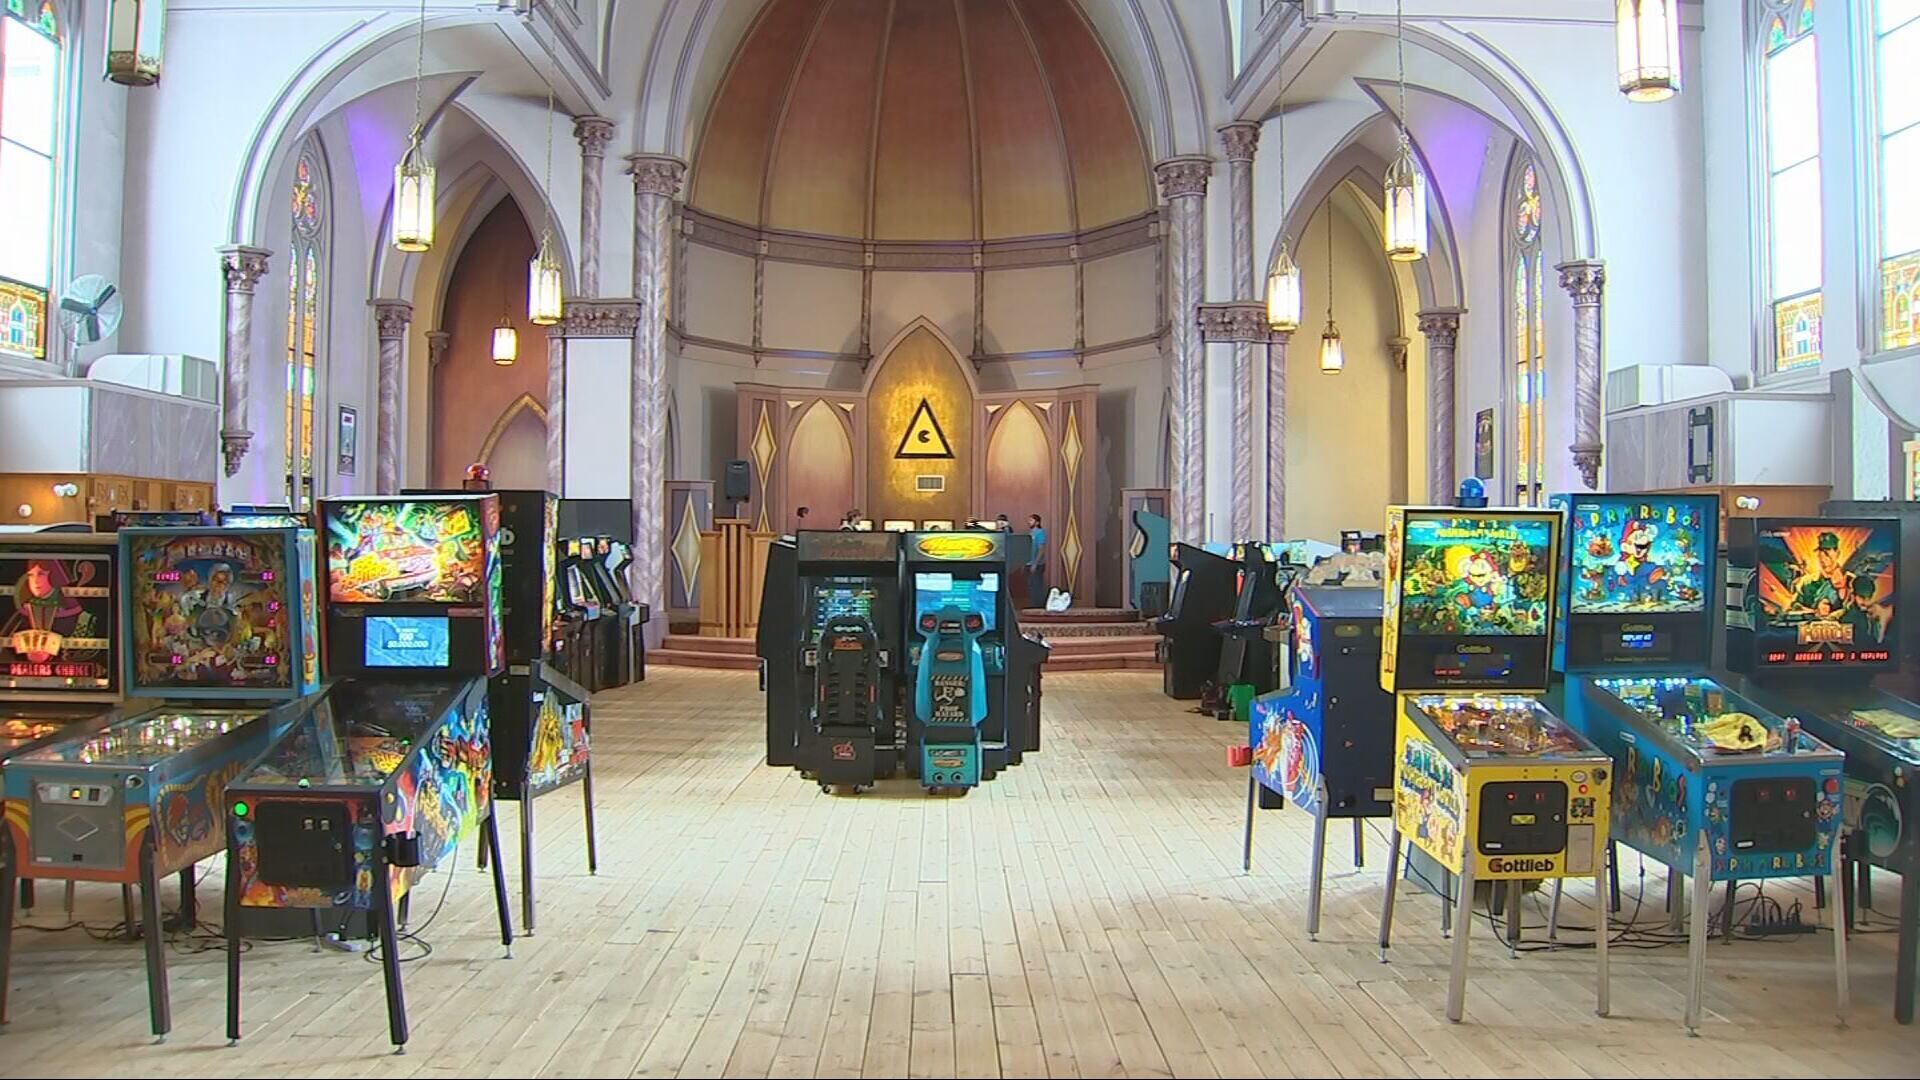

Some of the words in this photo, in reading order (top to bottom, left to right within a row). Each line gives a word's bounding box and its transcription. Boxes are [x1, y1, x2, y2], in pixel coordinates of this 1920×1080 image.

[10, 664, 52, 676] DEALERS
[55, 664, 88, 676] CHOICE
[1488, 857, 1554, 873] Gottlieb
